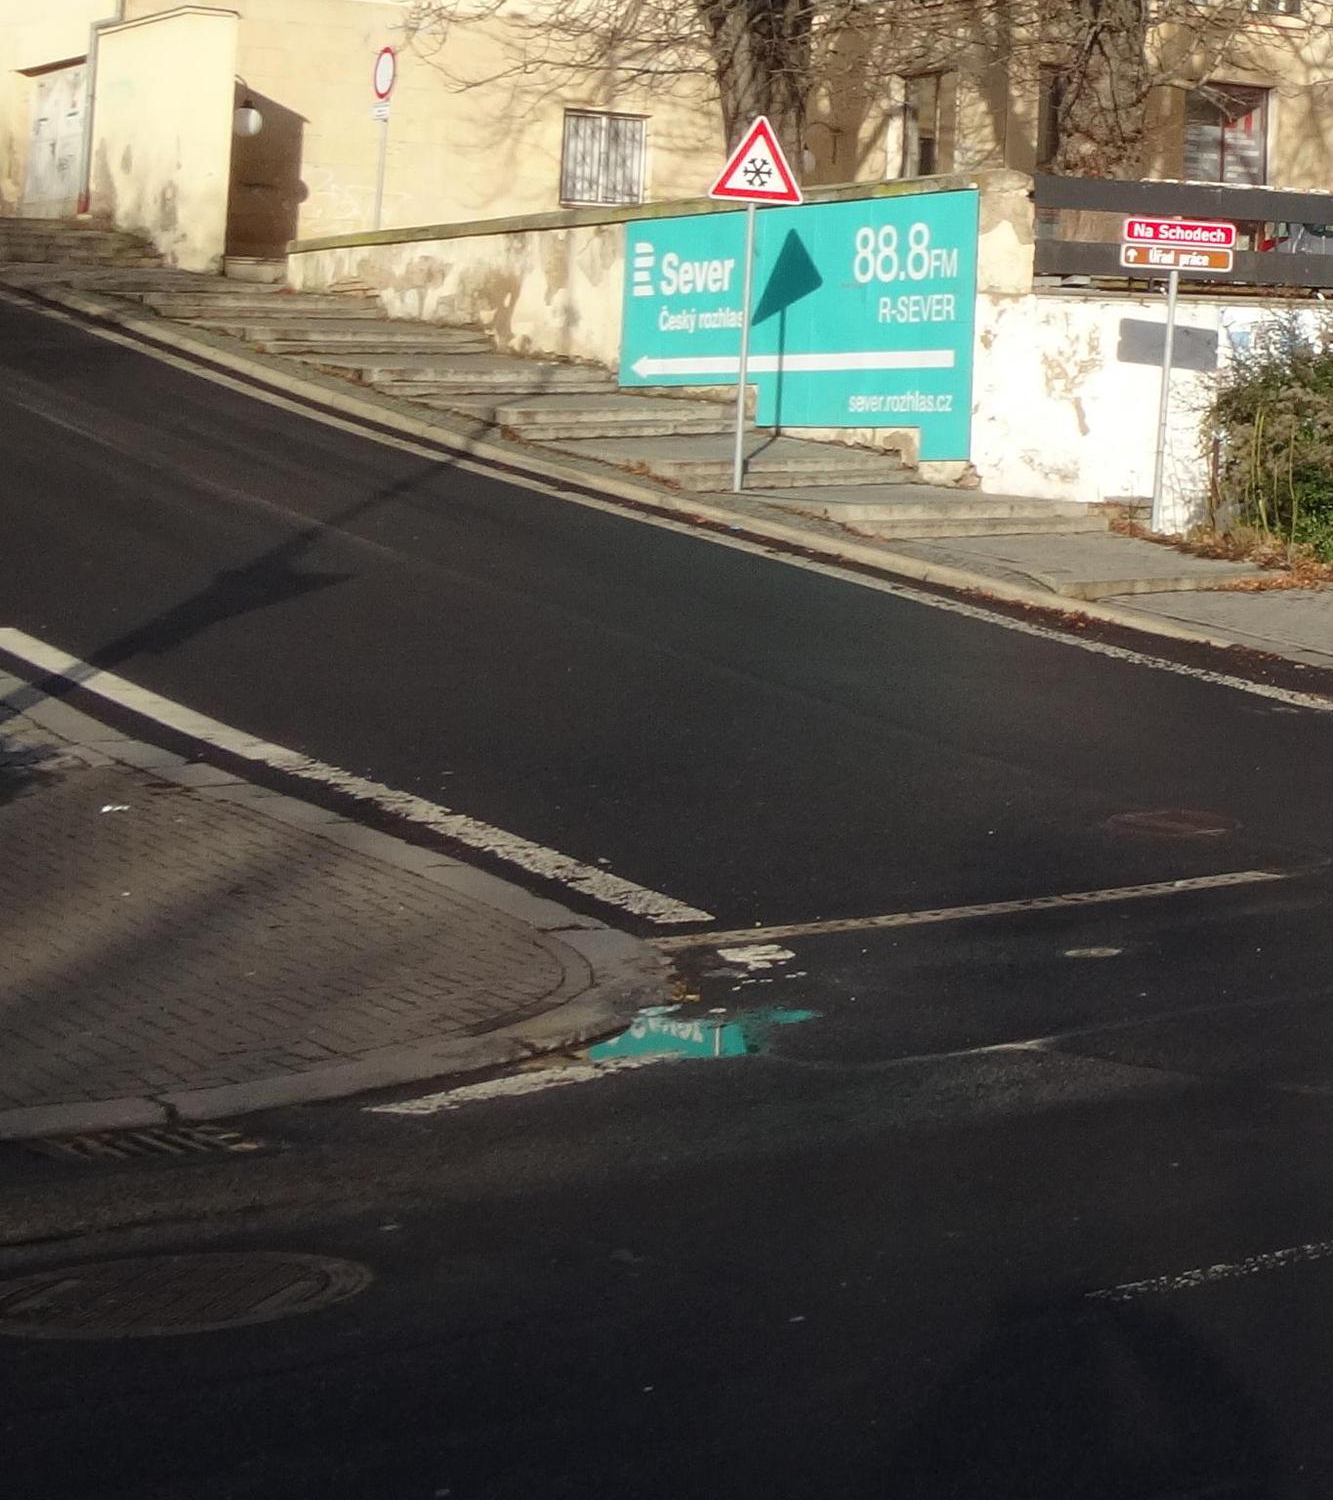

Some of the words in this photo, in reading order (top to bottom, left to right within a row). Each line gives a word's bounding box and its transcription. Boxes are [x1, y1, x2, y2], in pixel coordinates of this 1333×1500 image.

[1133, 223, 1154, 238] Na
[1158, 224, 1226, 243] Schodech
[660, 252, 735, 296] Sever
[658, 305, 697, 333] Český
[698, 307, 744, 329] rozhlas
[878, 294, 955, 324] R-SEVER
[848, 390, 953, 413] sever.rozhlas.cz
